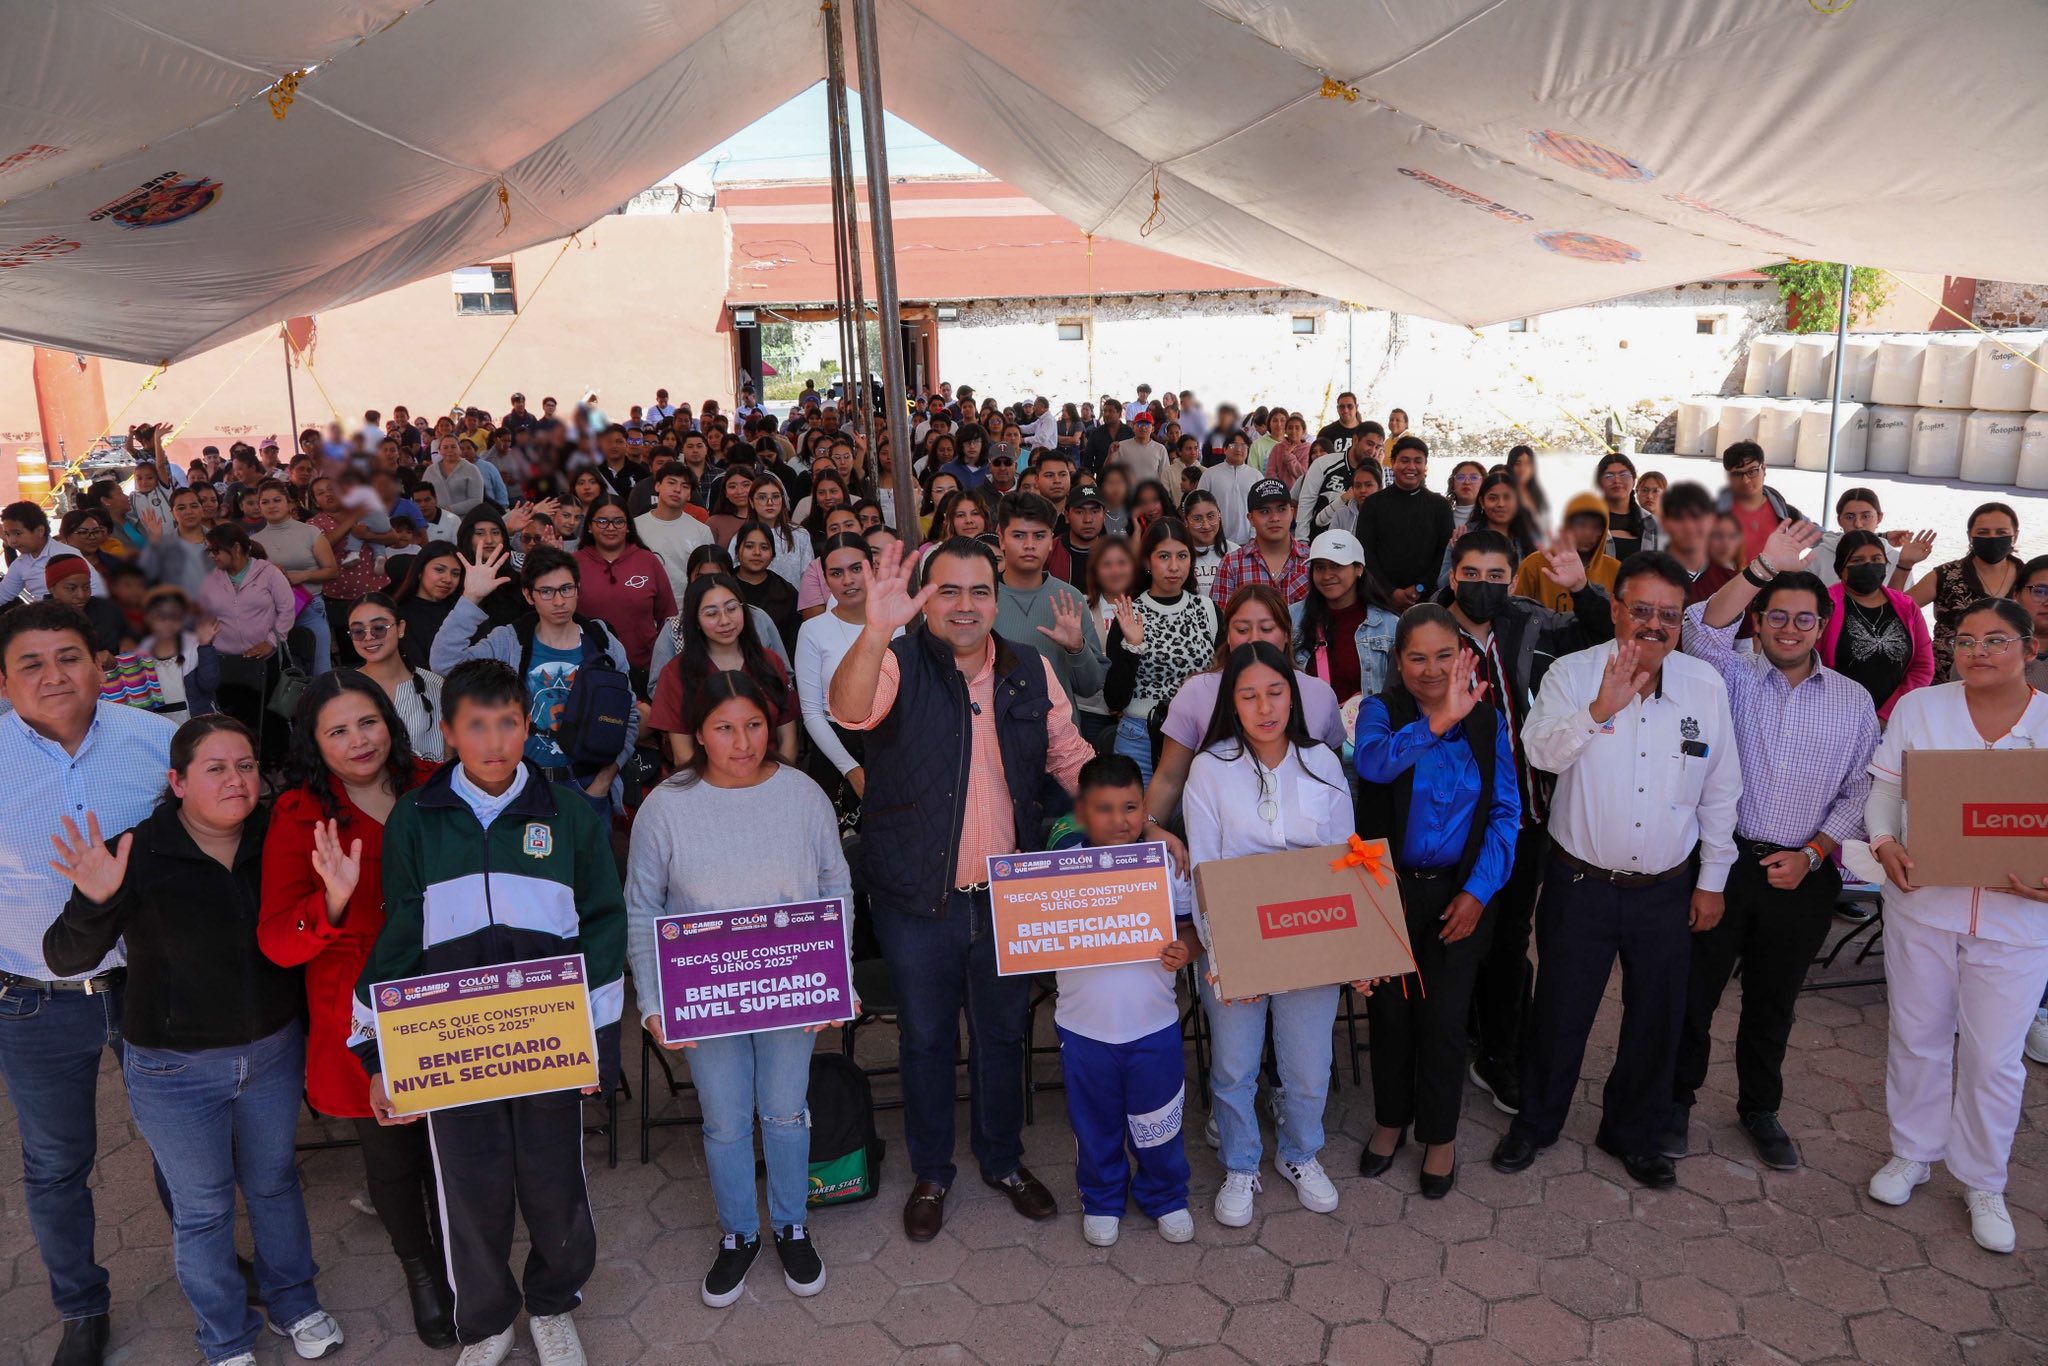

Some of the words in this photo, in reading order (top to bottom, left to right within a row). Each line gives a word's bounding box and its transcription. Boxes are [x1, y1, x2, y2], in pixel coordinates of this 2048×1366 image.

[1334, 437, 1352, 452] GA
[1972, 810, 2048, 829] Lenov
[1058, 855, 1093, 865] COLÓN
[1051, 889, 1075, 901] QUE
[1079, 881, 1157, 896] CONSTRUYEN
[1041, 897, 1088, 912] SUEÑOS
[731, 914, 767, 925] COLÓN
[1018, 912, 1150, 938] BENEFICIARIO
[1266, 905, 1347, 930] Lenovo
[721, 949, 749, 962] QUE
[751, 940, 834, 957] CONSTRUYEN
[1009, 936, 1065, 955] NIVEL
[1070, 927, 1163, 950] PRIMARIA
[710, 959, 762, 975] SUEÑOS
[458, 974, 499, 988] COLÓN
[525, 974, 552, 983] COLÓN
[685, 972, 826, 1003] BENEFICIARIO
[450, 1013, 480, 1028] QUE
[483, 1000, 575, 1023] CONSTRUYEN
[675, 1000, 735, 1021] NIVEL
[739, 987, 840, 1013] SUPERIOR
[438, 1022, 495, 1042] SUEÑOS
[418, 1036, 561, 1071] BENEFICIARIO
[393, 1070, 454, 1094] NIVEL
[460, 1051, 591, 1083] SECUNDARIA
[808, 1184, 836, 1196] UAKER
[838, 1176, 863, 1190] STATE
